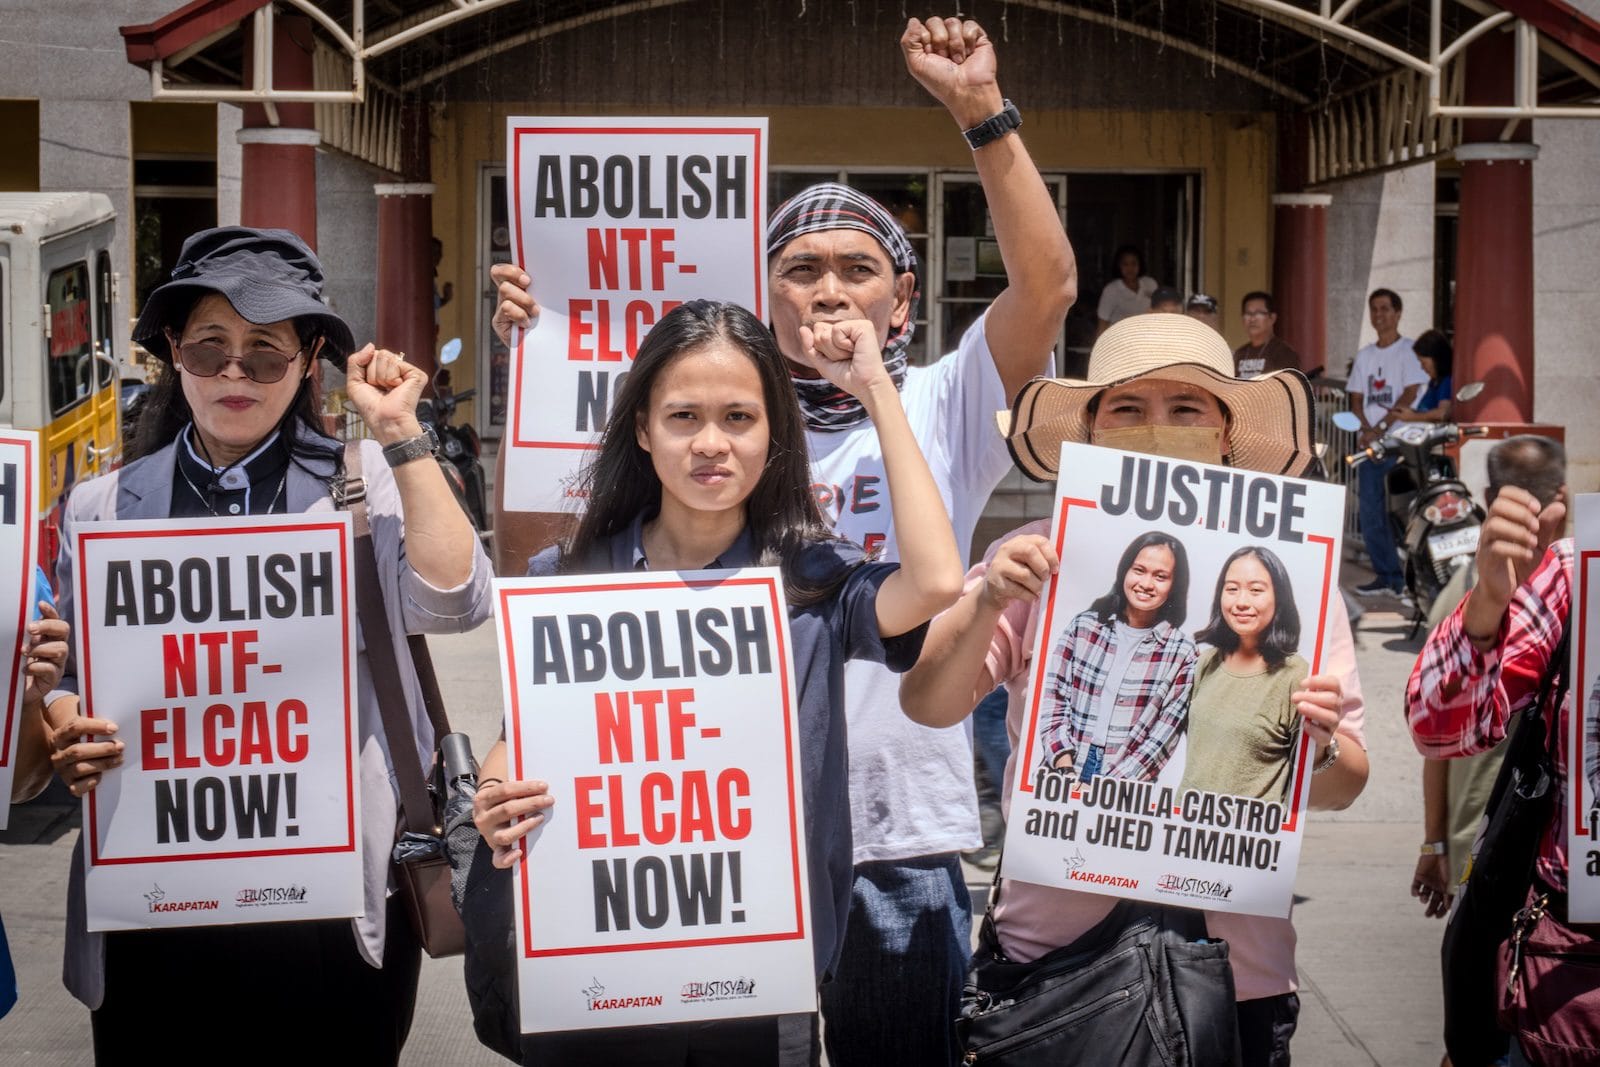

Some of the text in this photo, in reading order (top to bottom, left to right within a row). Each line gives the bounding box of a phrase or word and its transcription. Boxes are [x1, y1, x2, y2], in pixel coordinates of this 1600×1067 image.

[534, 154, 746, 220] ABOLISH
[586, 227, 697, 291] NTF-
[567, 298, 683, 363] ELC
[1101, 456, 1307, 544] JUSTICE
[103, 551, 335, 627] ABOLISH
[162, 629, 282, 699] NTF-
[533, 606, 772, 685] ABOLISH
[140, 698, 310, 771] ELCAC
[594, 688, 721, 765] NTF-
[154, 772, 300, 845] NOW!
[573, 767, 753, 850] ELCAC
[1034, 767, 1282, 835] for JONILA CASTRO
[1025, 808, 1282, 872] and JHED TAMANO!
[153, 900, 219, 913] KARAPATAN
[592, 851, 746, 933] NOW!
[1070, 870, 1139, 889] KARAPATAN
[1166, 874, 1223, 897] HUSTISYA
[592, 996, 662, 1011] KARAPATAN
